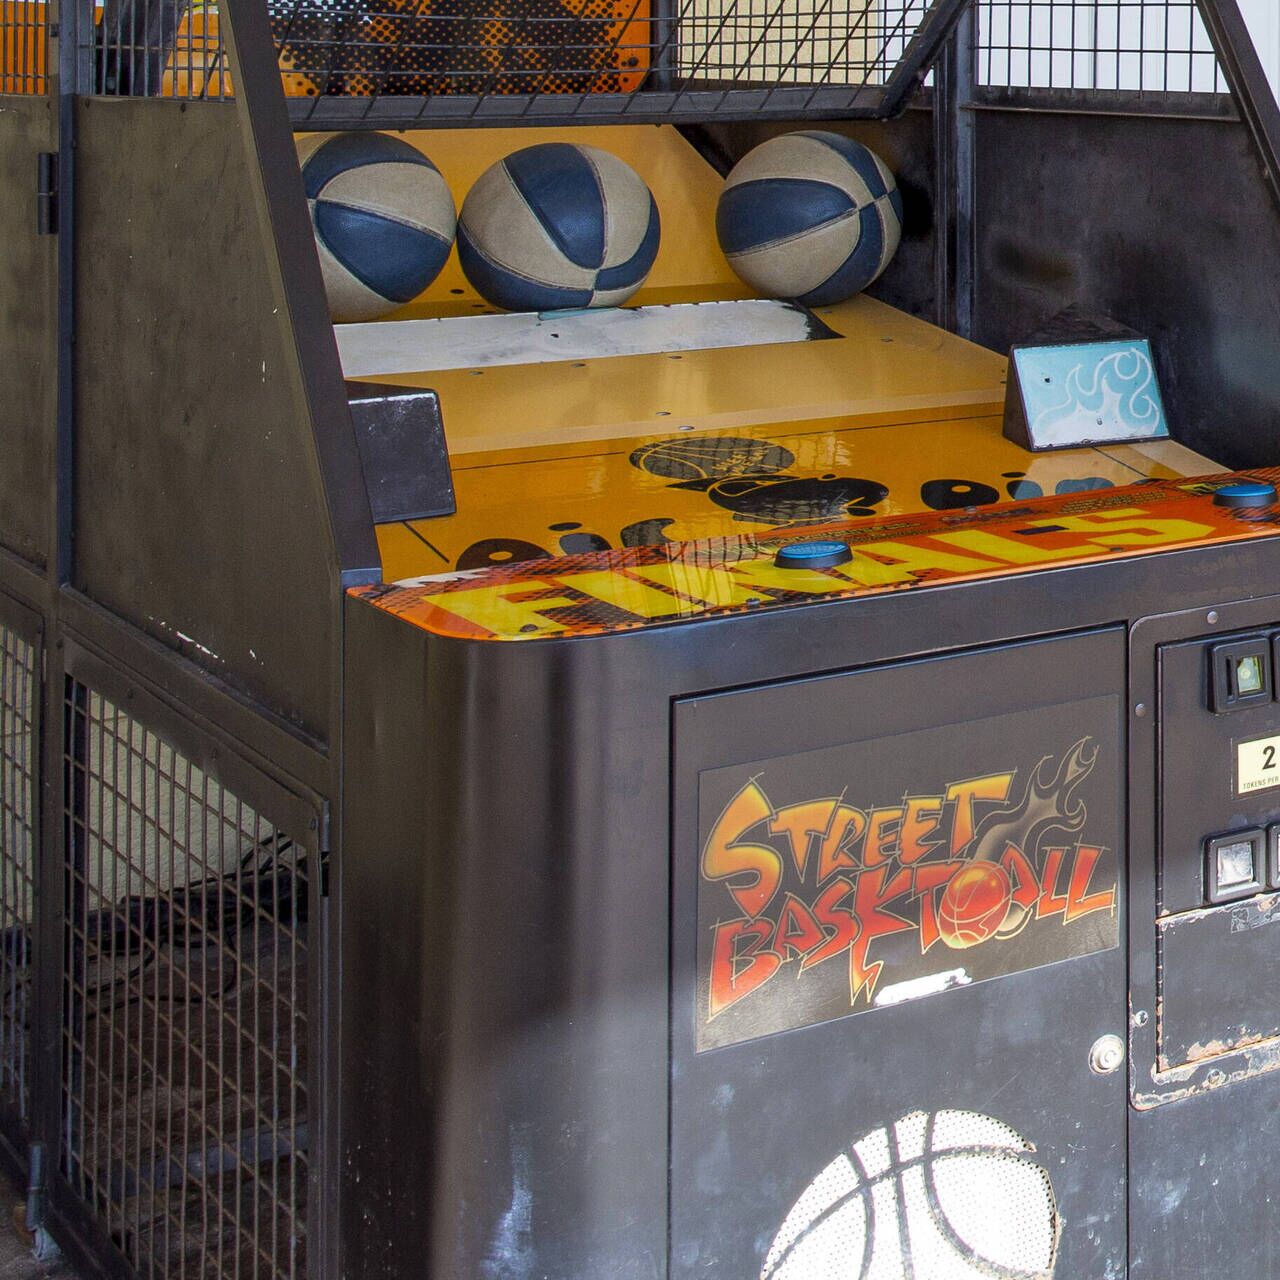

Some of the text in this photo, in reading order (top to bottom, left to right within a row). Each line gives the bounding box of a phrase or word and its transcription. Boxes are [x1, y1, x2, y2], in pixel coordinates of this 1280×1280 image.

[1262, 745, 1277, 770] 2
[1243, 779, 1267, 790] TOKENS
[1267, 775, 1280, 784] PER
[703, 770, 1017, 920] STREET
